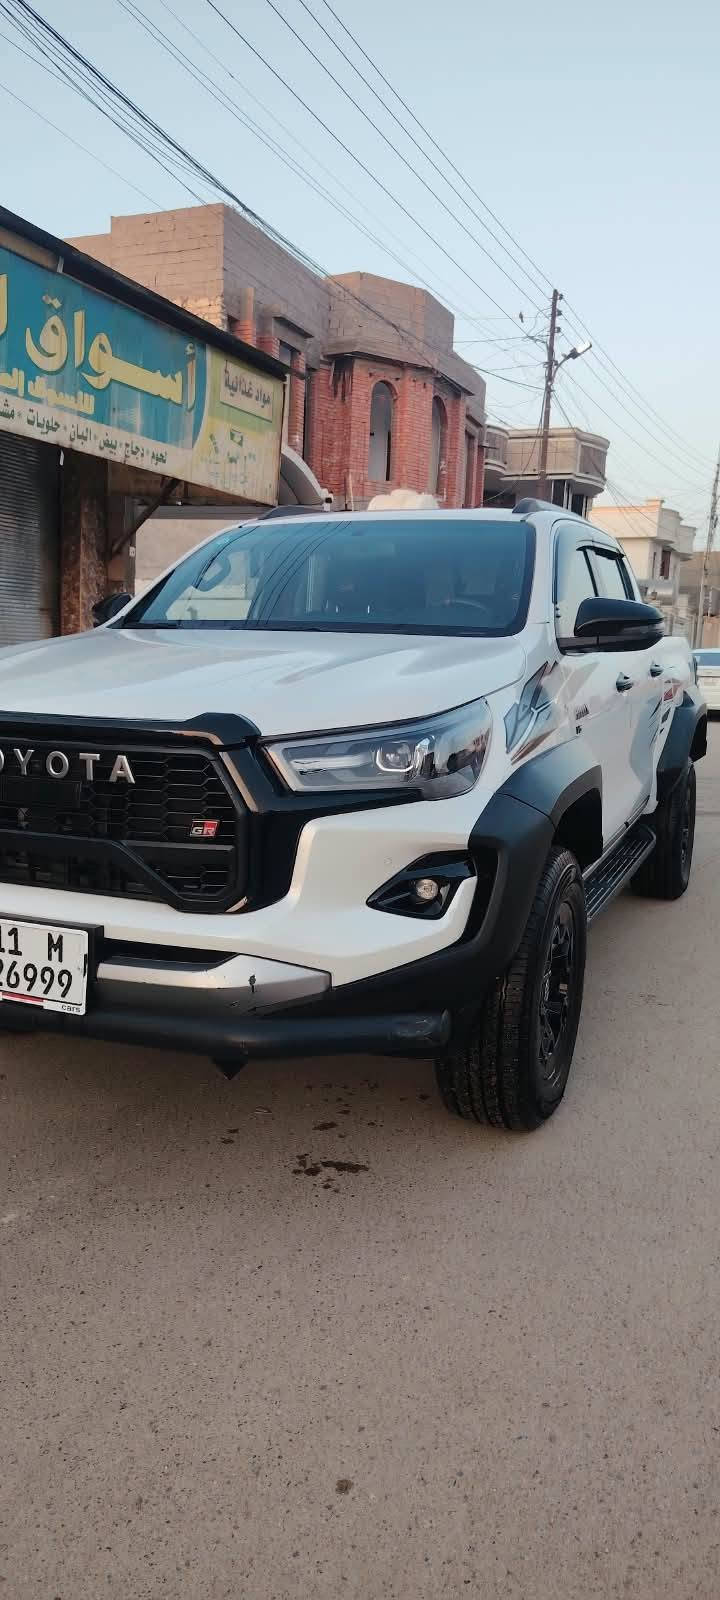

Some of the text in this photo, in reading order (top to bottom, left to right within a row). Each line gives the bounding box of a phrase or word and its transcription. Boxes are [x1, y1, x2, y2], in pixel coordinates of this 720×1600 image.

[25, 294, 197, 414] أسواق
[255, 387, 271, 409] مواد
[26, 408, 60, 435] حلويات
[99, 432, 118, 456] بيض
[0, 748, 136, 784] YOTA
[47, 932, 63, 963] M
[0, 958, 73, 998] 6999
[61, 1004, 81, 1013] cars
